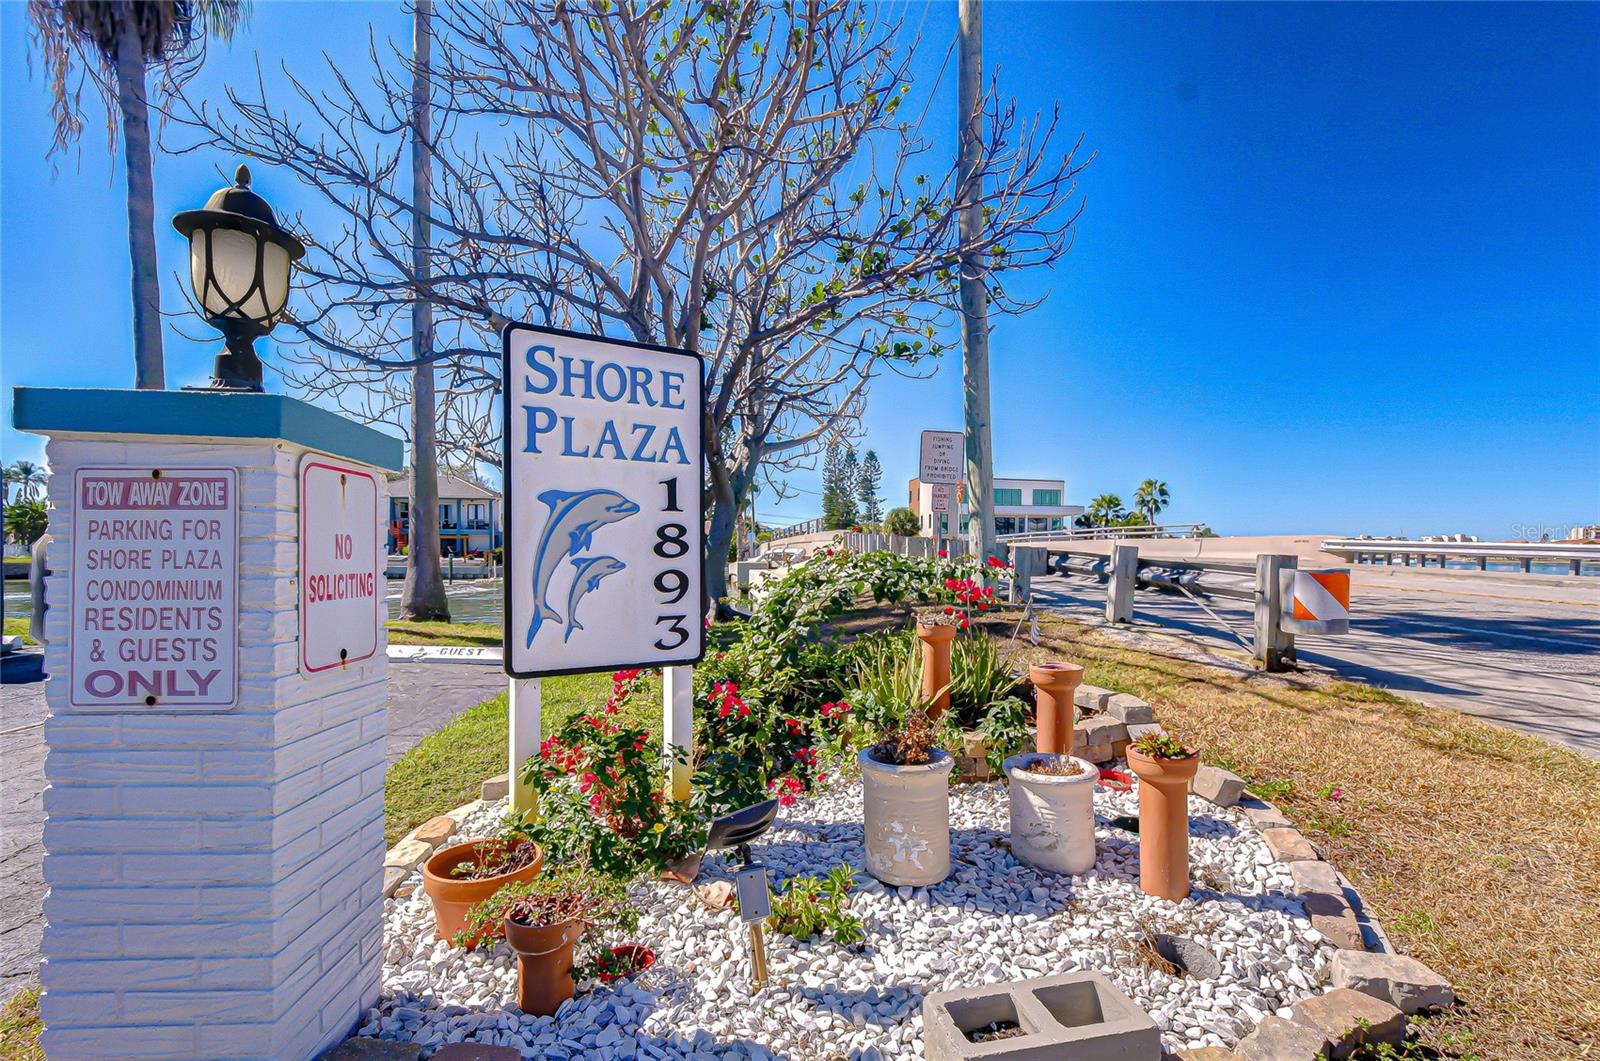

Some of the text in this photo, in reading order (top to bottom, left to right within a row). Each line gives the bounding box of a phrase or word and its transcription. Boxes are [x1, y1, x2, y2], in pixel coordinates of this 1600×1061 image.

[524, 345, 685, 410] SHORE
[521, 405, 691, 465] PLAZA
[85, 481, 225, 506] TOW AWAY ZONE
[87, 519, 222, 541] PARKING FOR
[86, 549, 223, 570] SHORE PLAZA
[335, 533, 352, 560] NO
[86, 579, 223, 602] CONDOMINIUM
[309, 572, 373, 603] SOLICITING
[84, 606, 223, 632] RESIDENTS
[89, 637, 218, 663] & GUESTS
[439, 647, 485, 656] GUEST
[84, 669, 222, 697] ONLY
